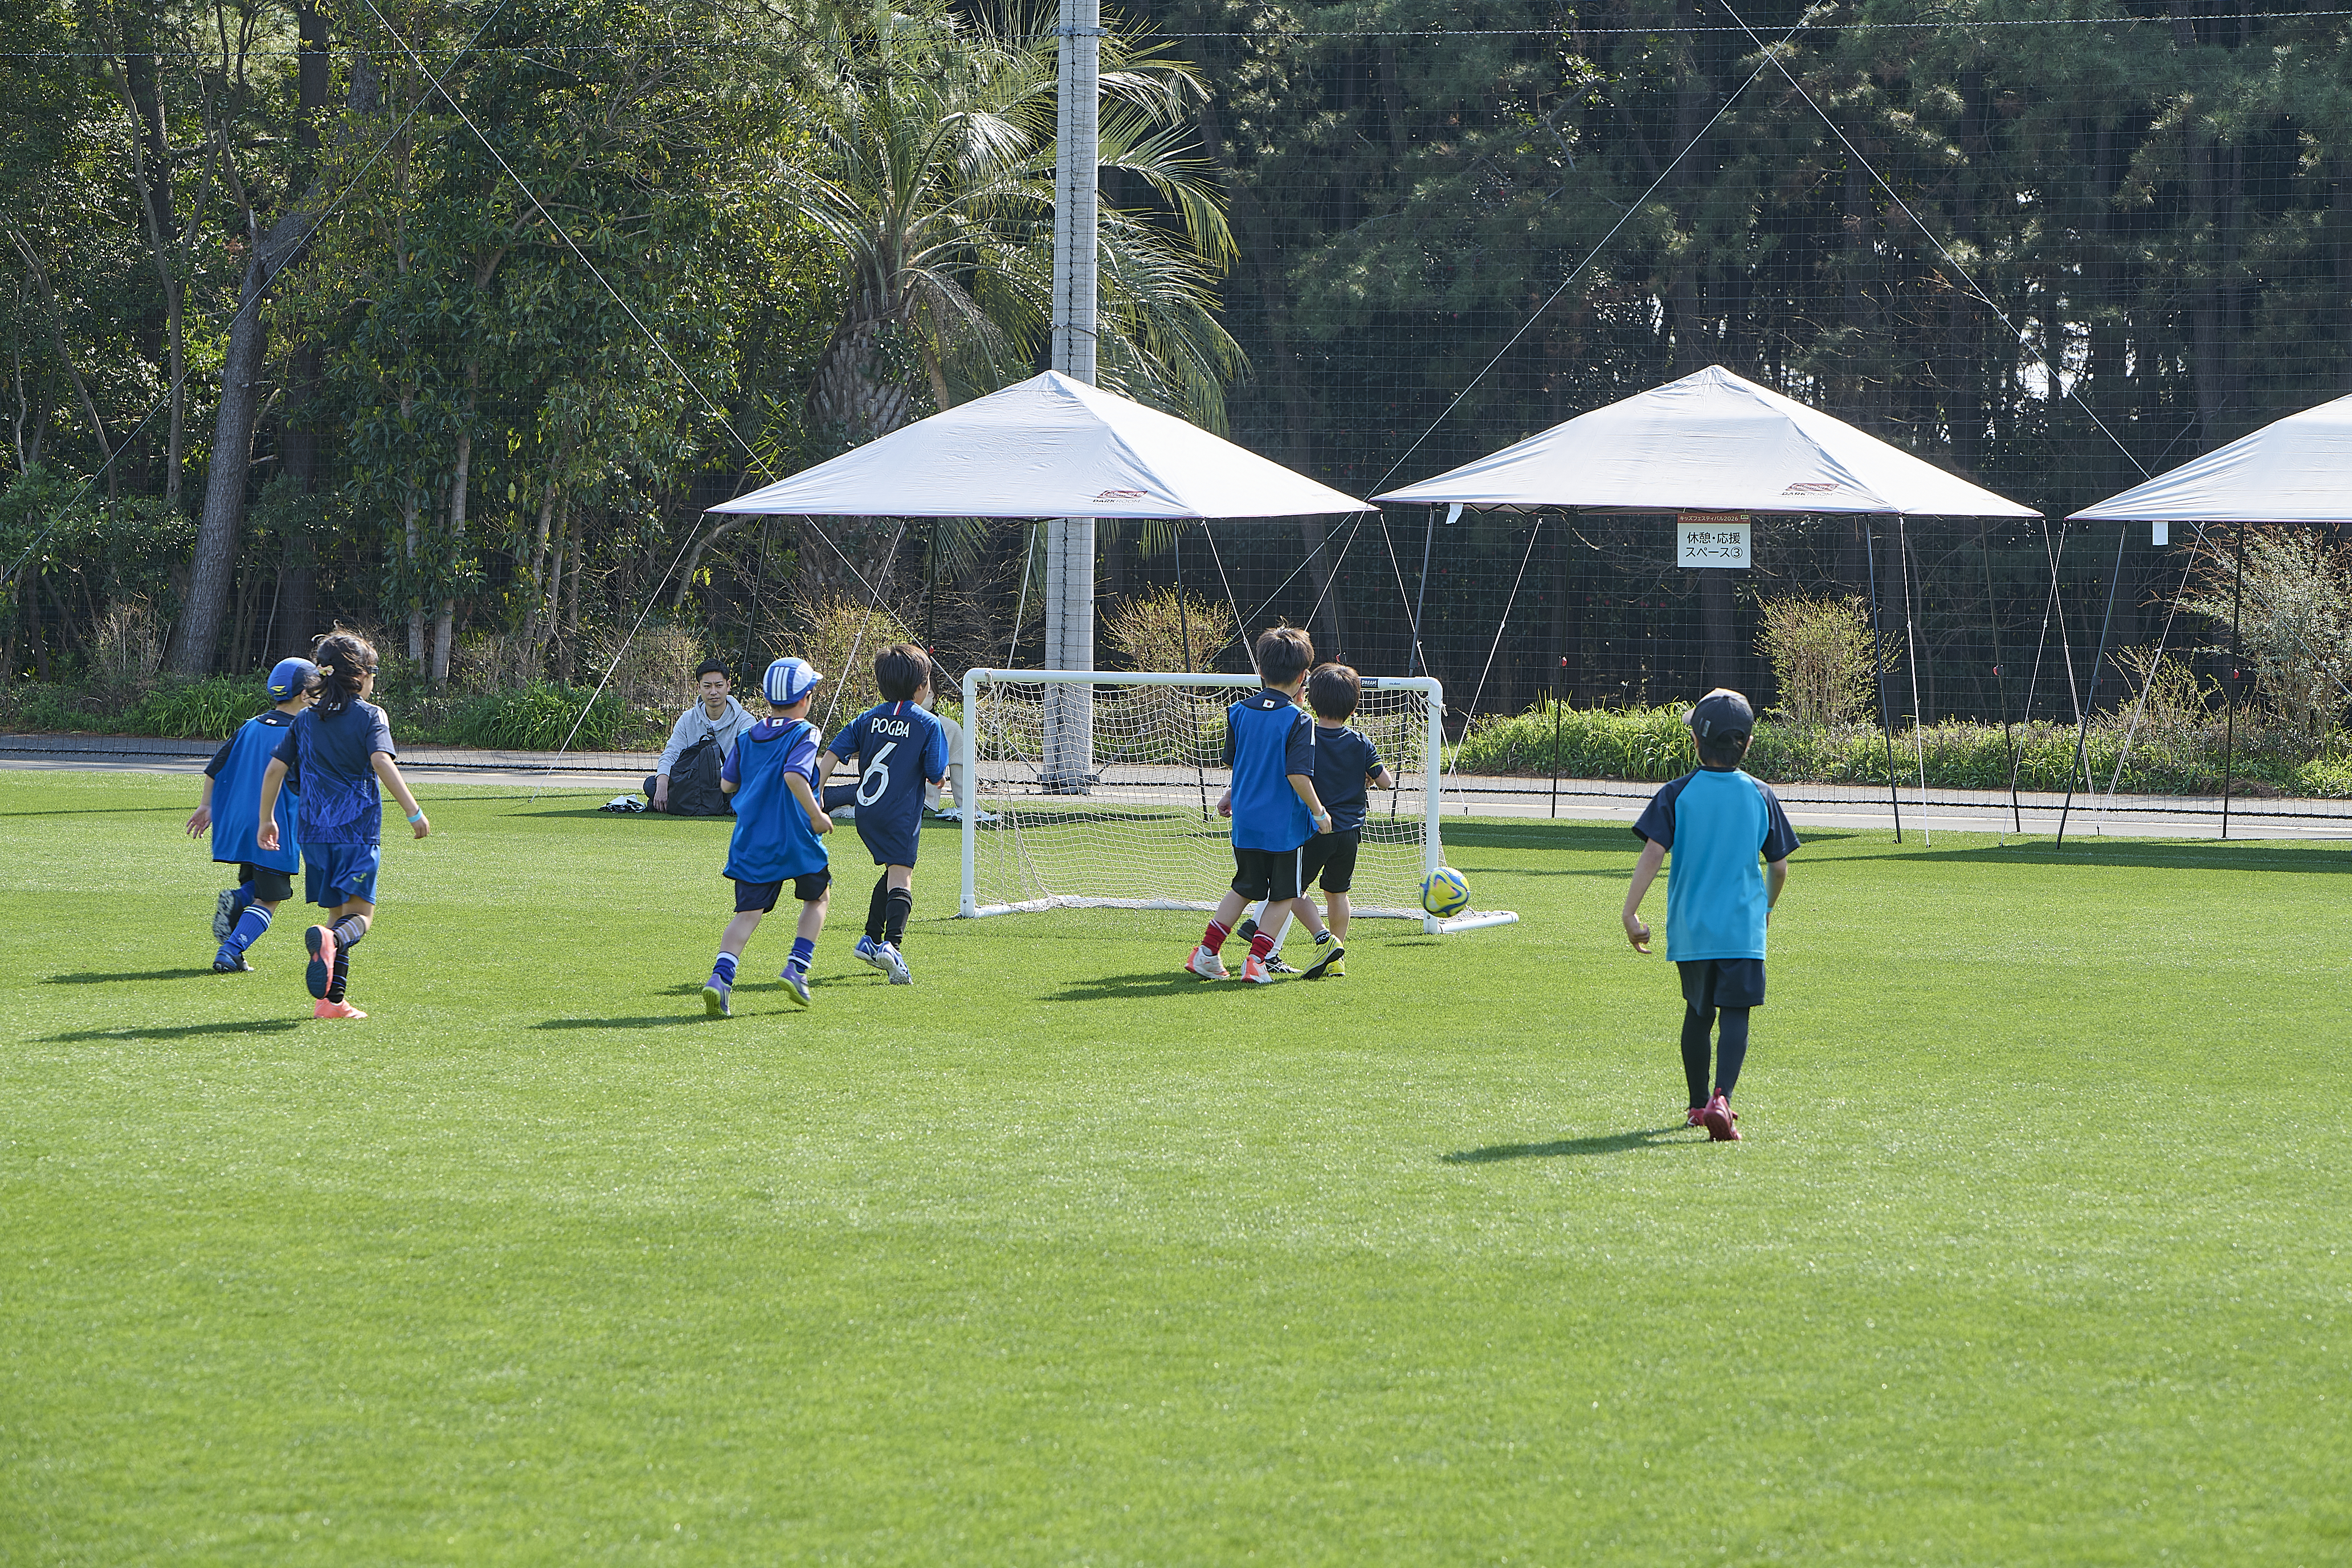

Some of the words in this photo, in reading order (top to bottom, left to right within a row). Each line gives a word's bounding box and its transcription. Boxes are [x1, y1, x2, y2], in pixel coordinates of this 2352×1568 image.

[1687, 532, 1741, 544] 休憩・応援
[1685, 546, 1743, 558] スペース③
[871, 717, 910, 738] POGBA
[856, 741, 897, 806] 6
